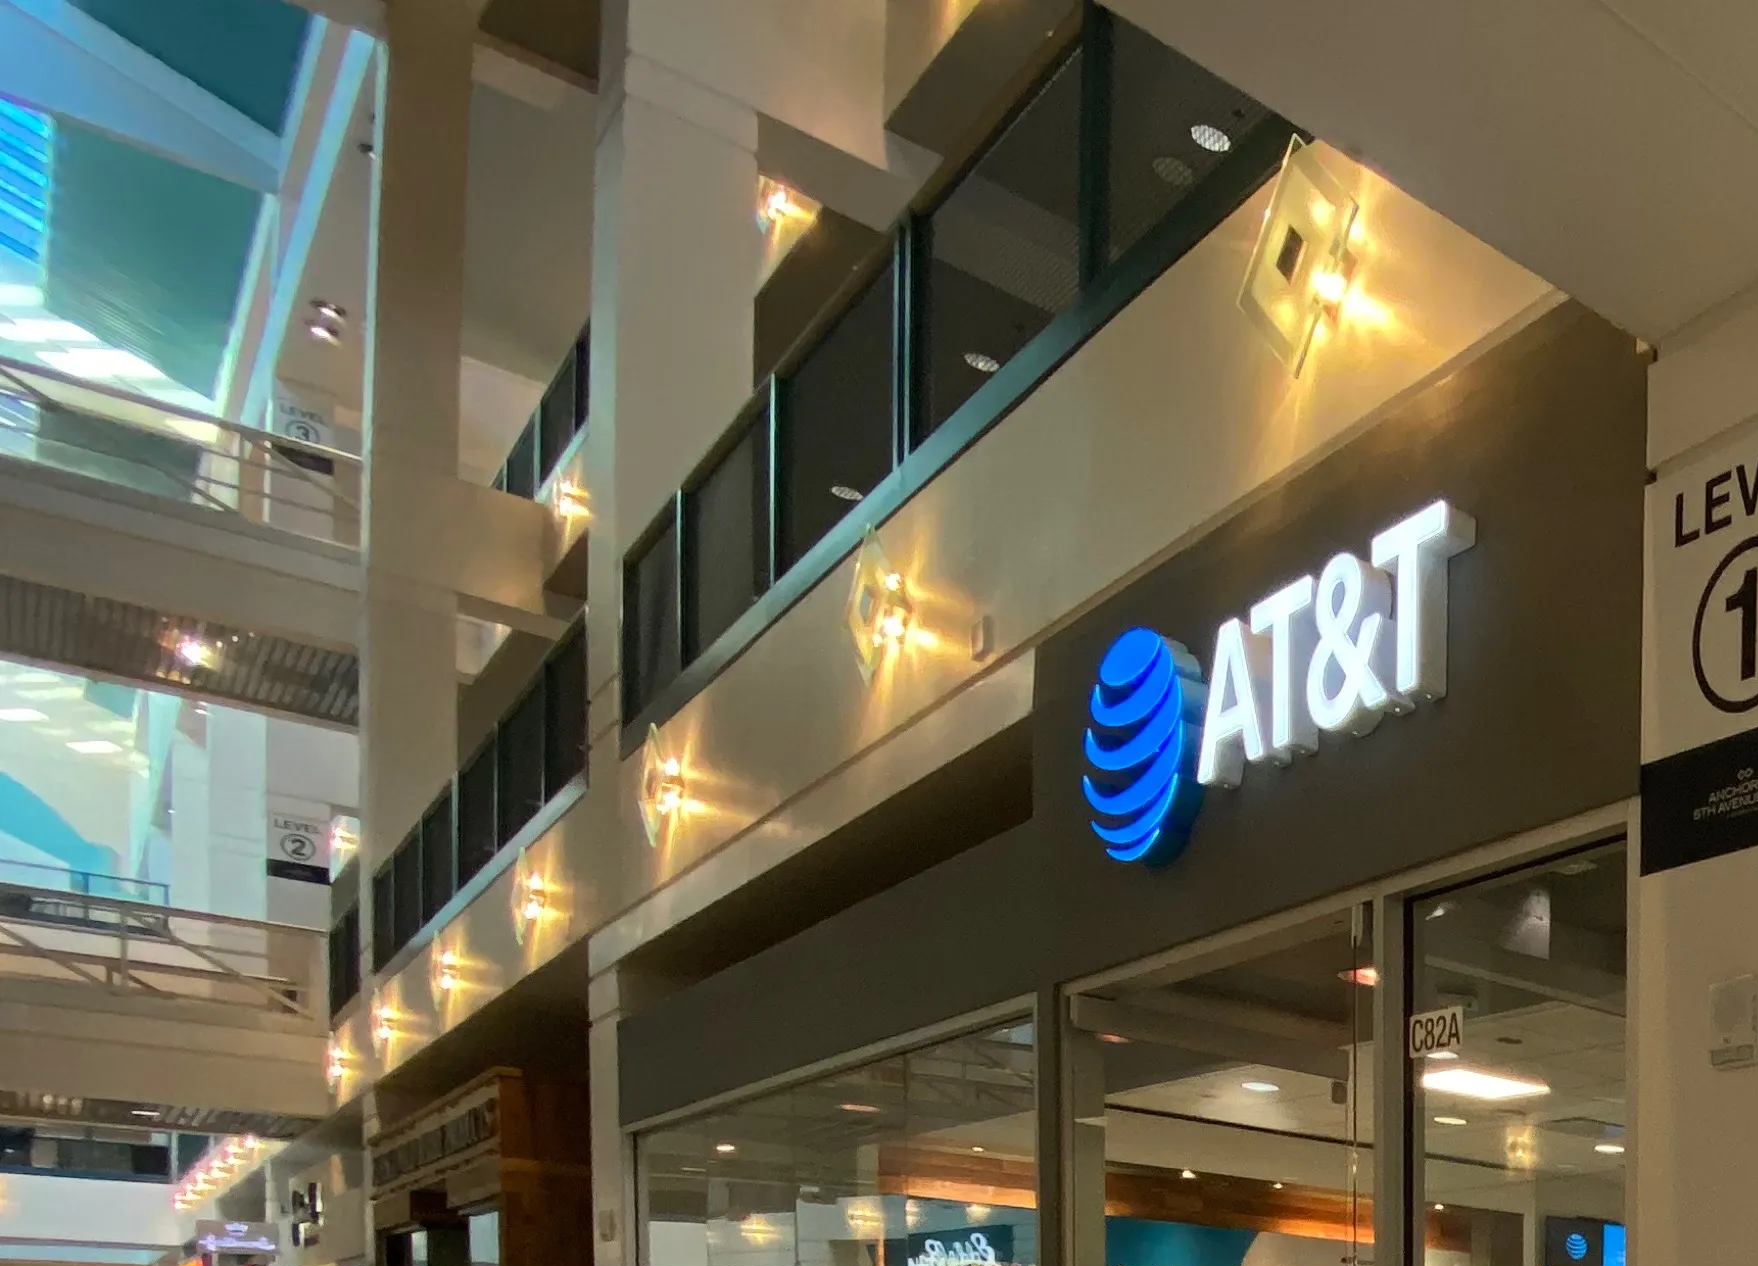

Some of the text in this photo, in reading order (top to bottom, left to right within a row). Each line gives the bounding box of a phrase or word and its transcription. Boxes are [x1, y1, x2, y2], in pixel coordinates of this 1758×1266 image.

[1197, 499, 1452, 788] AT&T
[1725, 567, 1758, 681] 1
[1693, 805, 1717, 820] 5TH
[291, 838, 306, 856] 2
[1411, 1012, 1460, 1052] C82A
